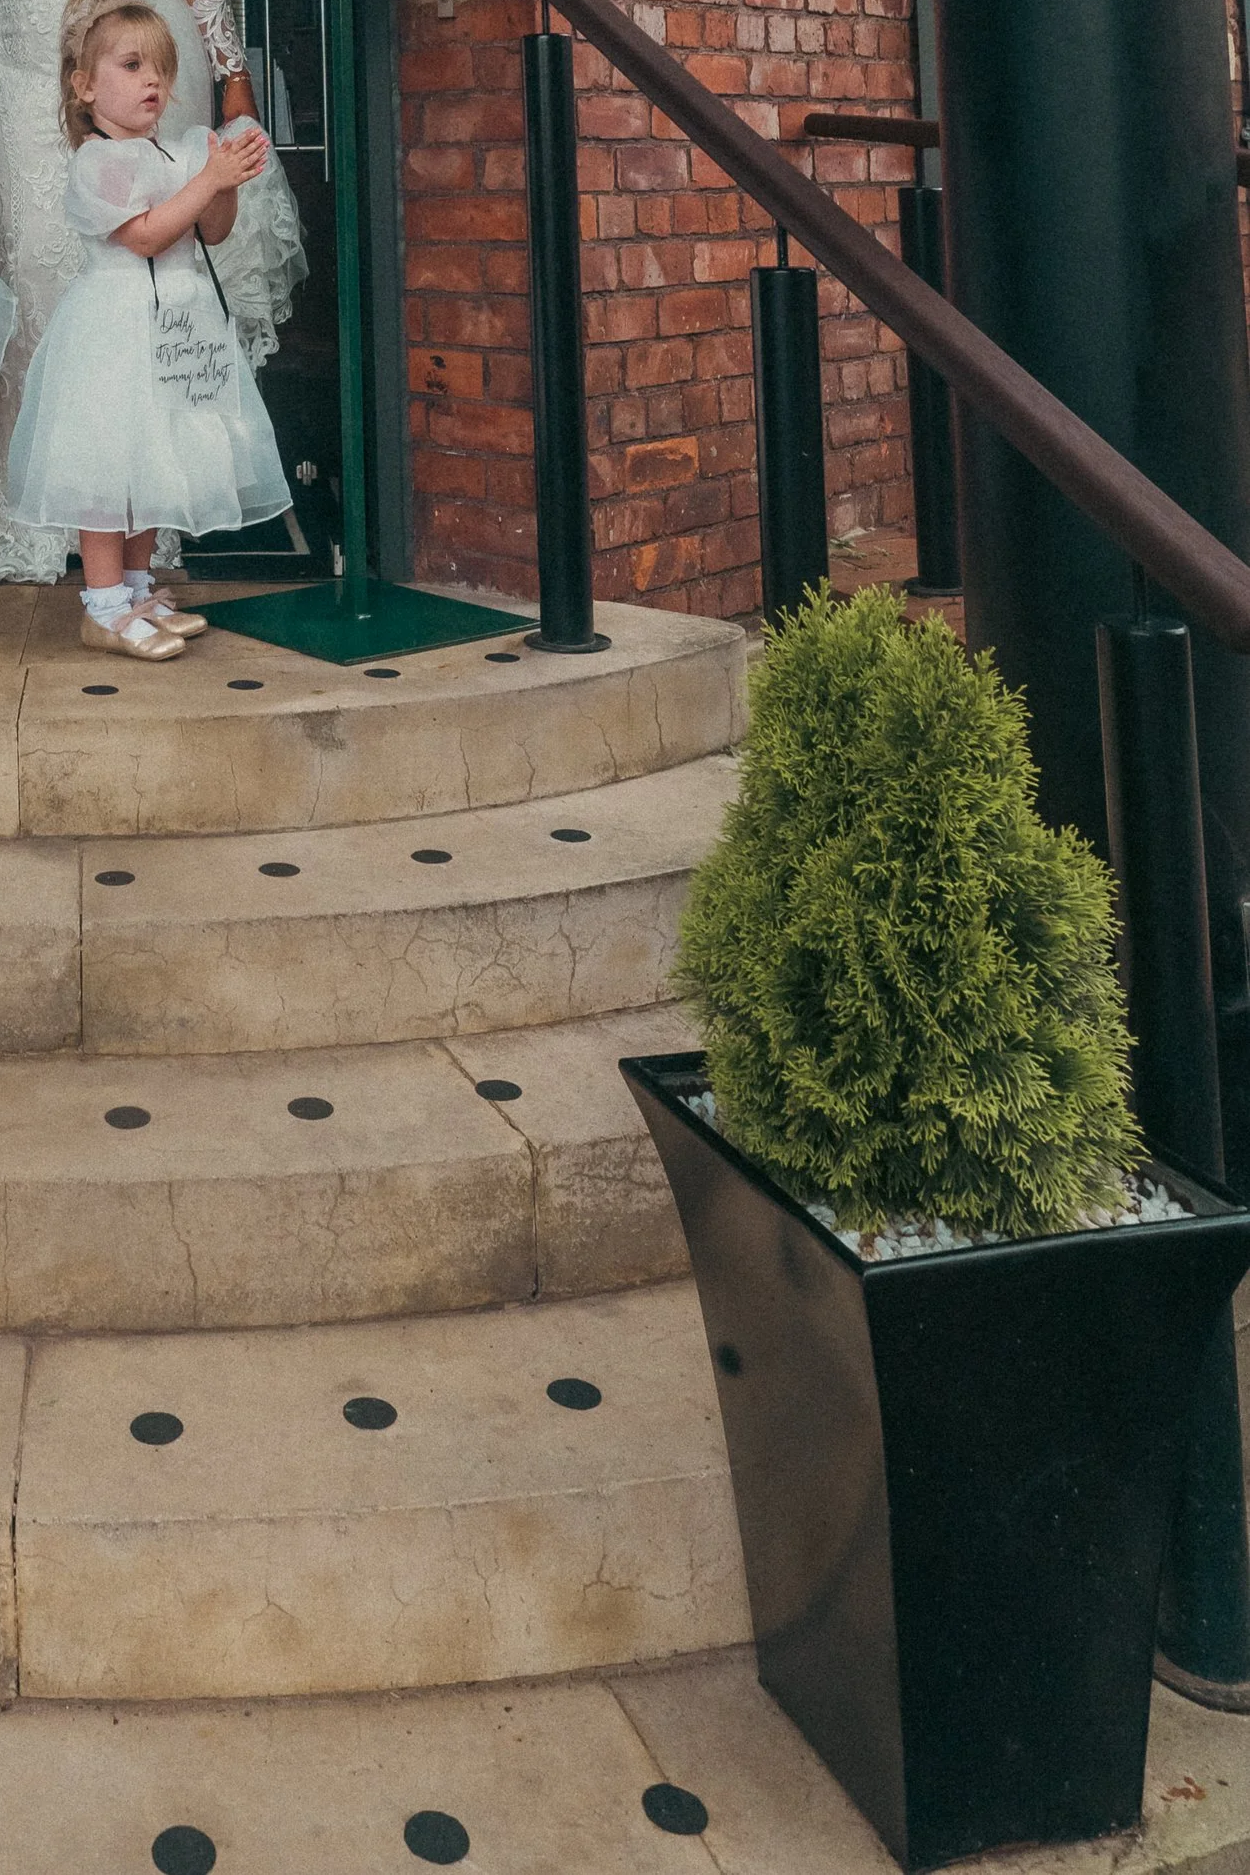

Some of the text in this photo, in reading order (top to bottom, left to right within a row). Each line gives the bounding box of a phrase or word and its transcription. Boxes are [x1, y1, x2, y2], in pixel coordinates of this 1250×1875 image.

[171, 342, 195, 362] time
[193, 340, 207, 359] to
[209, 342, 227, 368] give
[212, 359, 234, 387] last
